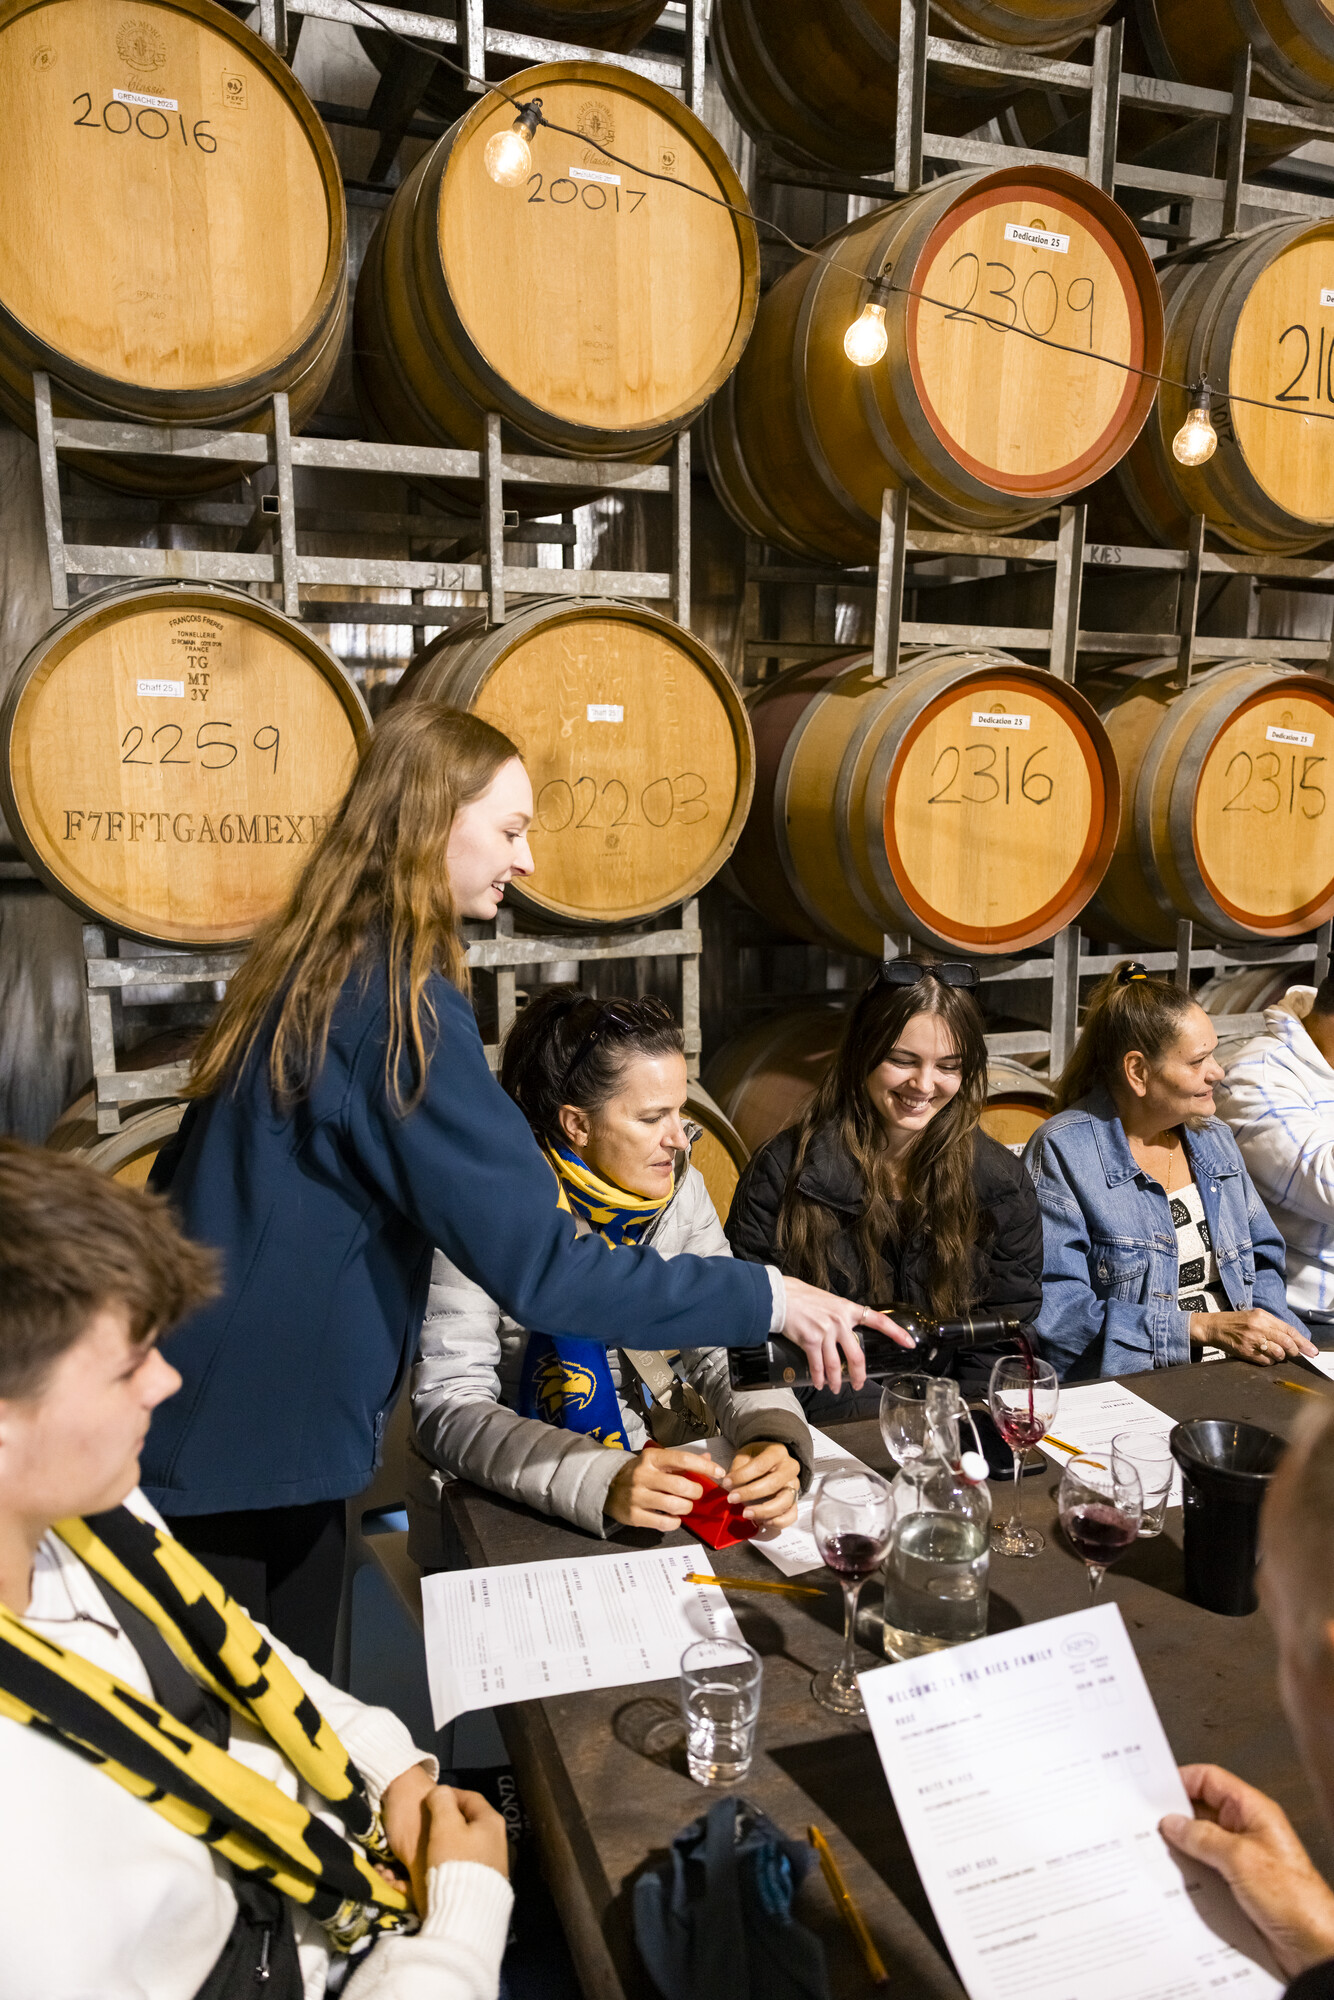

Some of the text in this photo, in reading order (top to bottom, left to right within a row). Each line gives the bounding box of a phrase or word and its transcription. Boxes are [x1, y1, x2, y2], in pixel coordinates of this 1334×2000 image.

[117, 92, 156, 106] GRENACHE
[72, 91, 218, 154] 20016
[526, 172, 647, 214] 20017
[1012, 229, 1061, 248] Dedication 25
[943, 251, 1096, 350] 2309
[1090, 544, 1122, 564] KIES
[177, 630, 217, 639] TONNELLERIE
[185, 645, 209, 653] FRANCE
[187, 655, 209, 669] TG
[187, 672, 211, 686] MT
[190, 688, 210, 701] 3Y
[978, 715, 1023, 726] Dedication 25
[121, 721, 280, 775] 2259
[927, 744, 1054, 806] 2316
[1222, 750, 1328, 820] 2315
[527, 772, 710, 833] 02203
